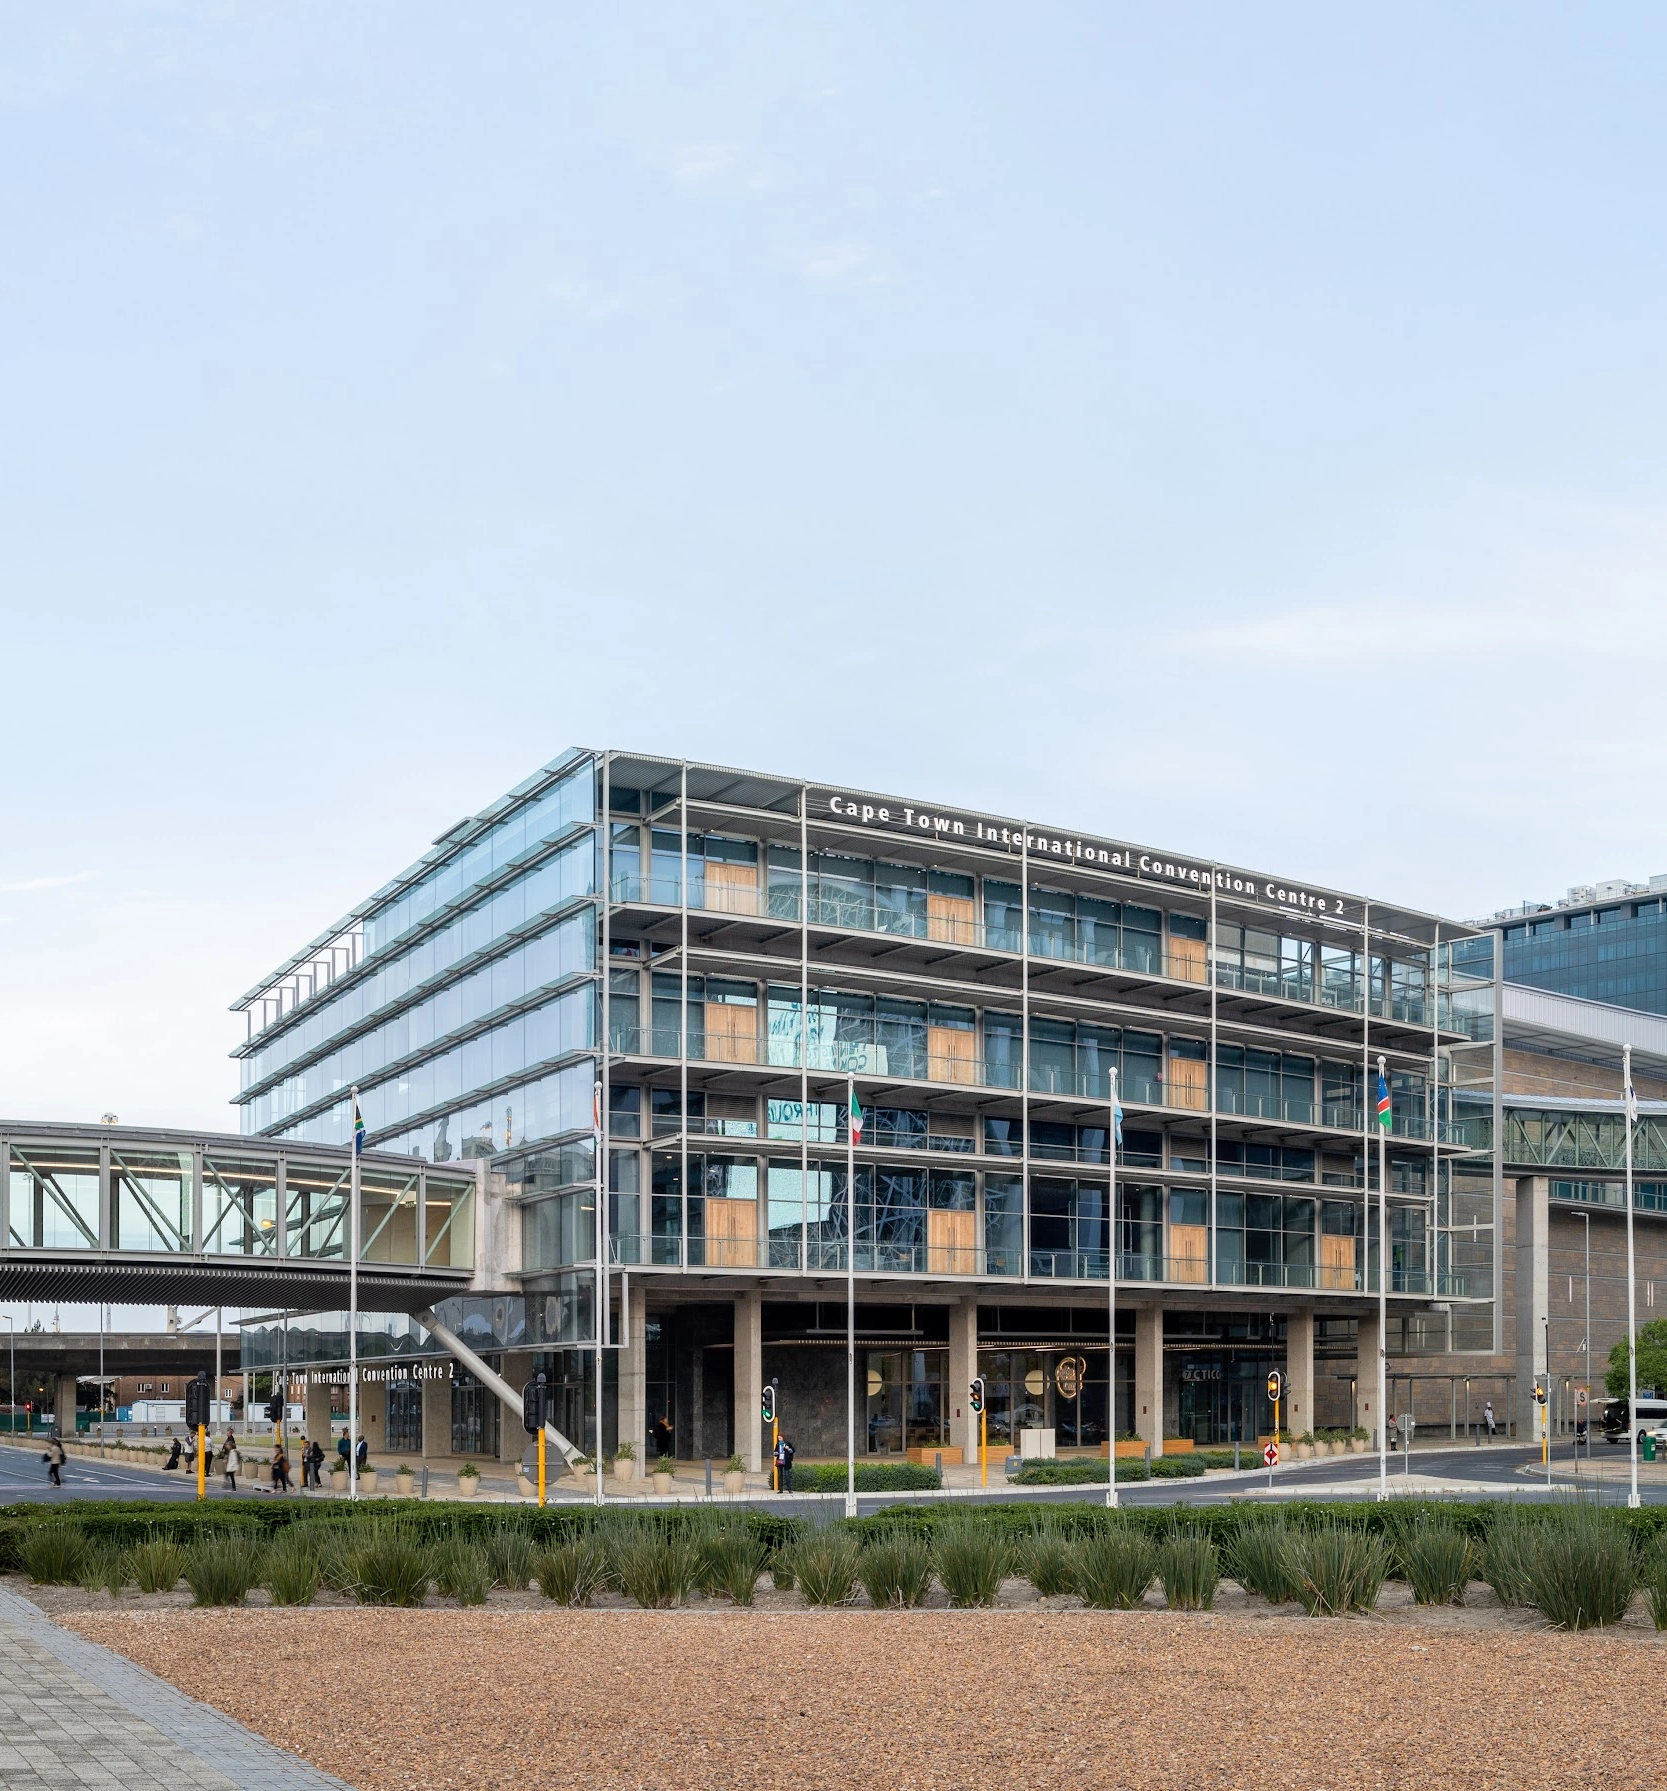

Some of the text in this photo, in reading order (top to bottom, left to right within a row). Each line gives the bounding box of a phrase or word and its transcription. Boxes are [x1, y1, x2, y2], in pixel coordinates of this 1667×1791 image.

[829, 796, 1345, 915] Cape Town International Convention Centre 2
[275, 1362, 454, 1387] Cae Town Internationl Convention Centre 2
